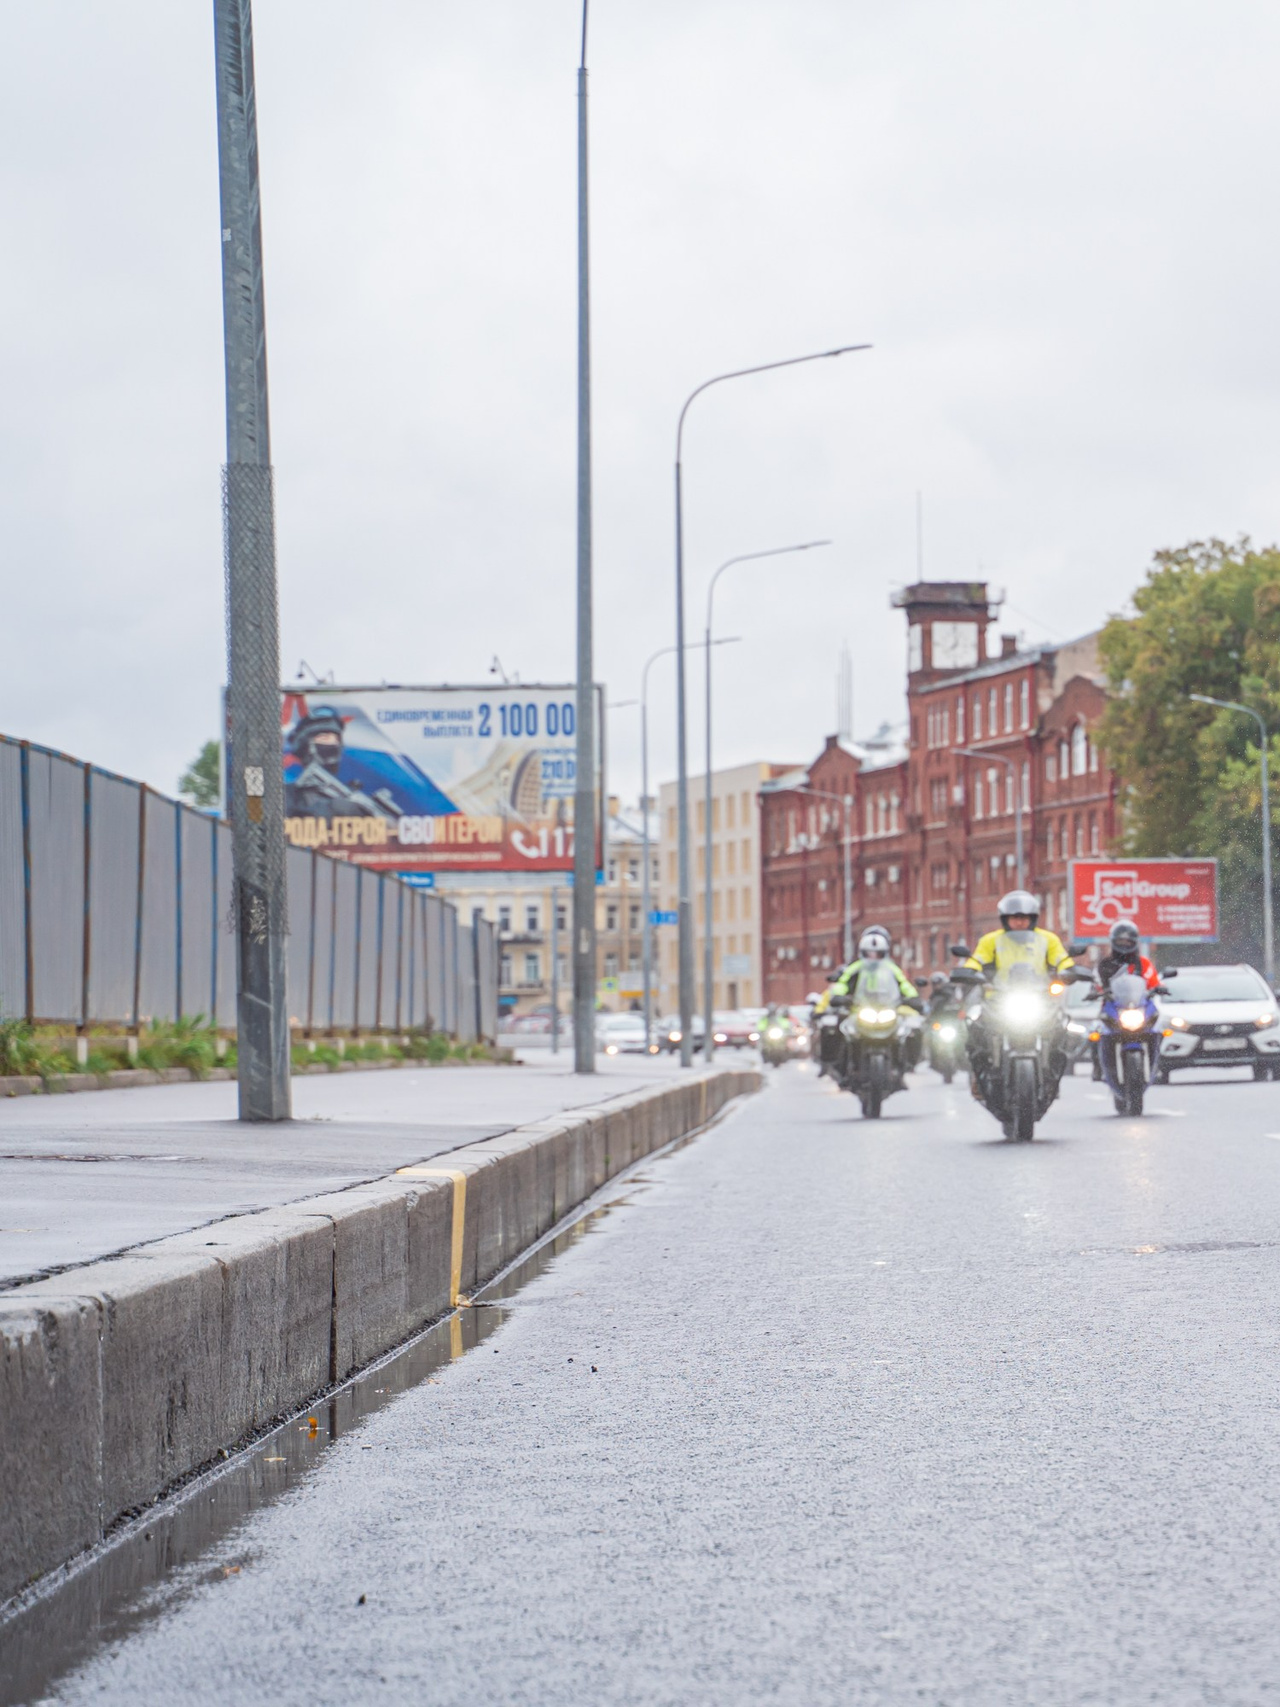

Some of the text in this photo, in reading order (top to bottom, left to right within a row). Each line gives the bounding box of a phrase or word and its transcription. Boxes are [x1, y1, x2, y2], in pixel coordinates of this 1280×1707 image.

[478, 703, 576, 738] 2 100 00
